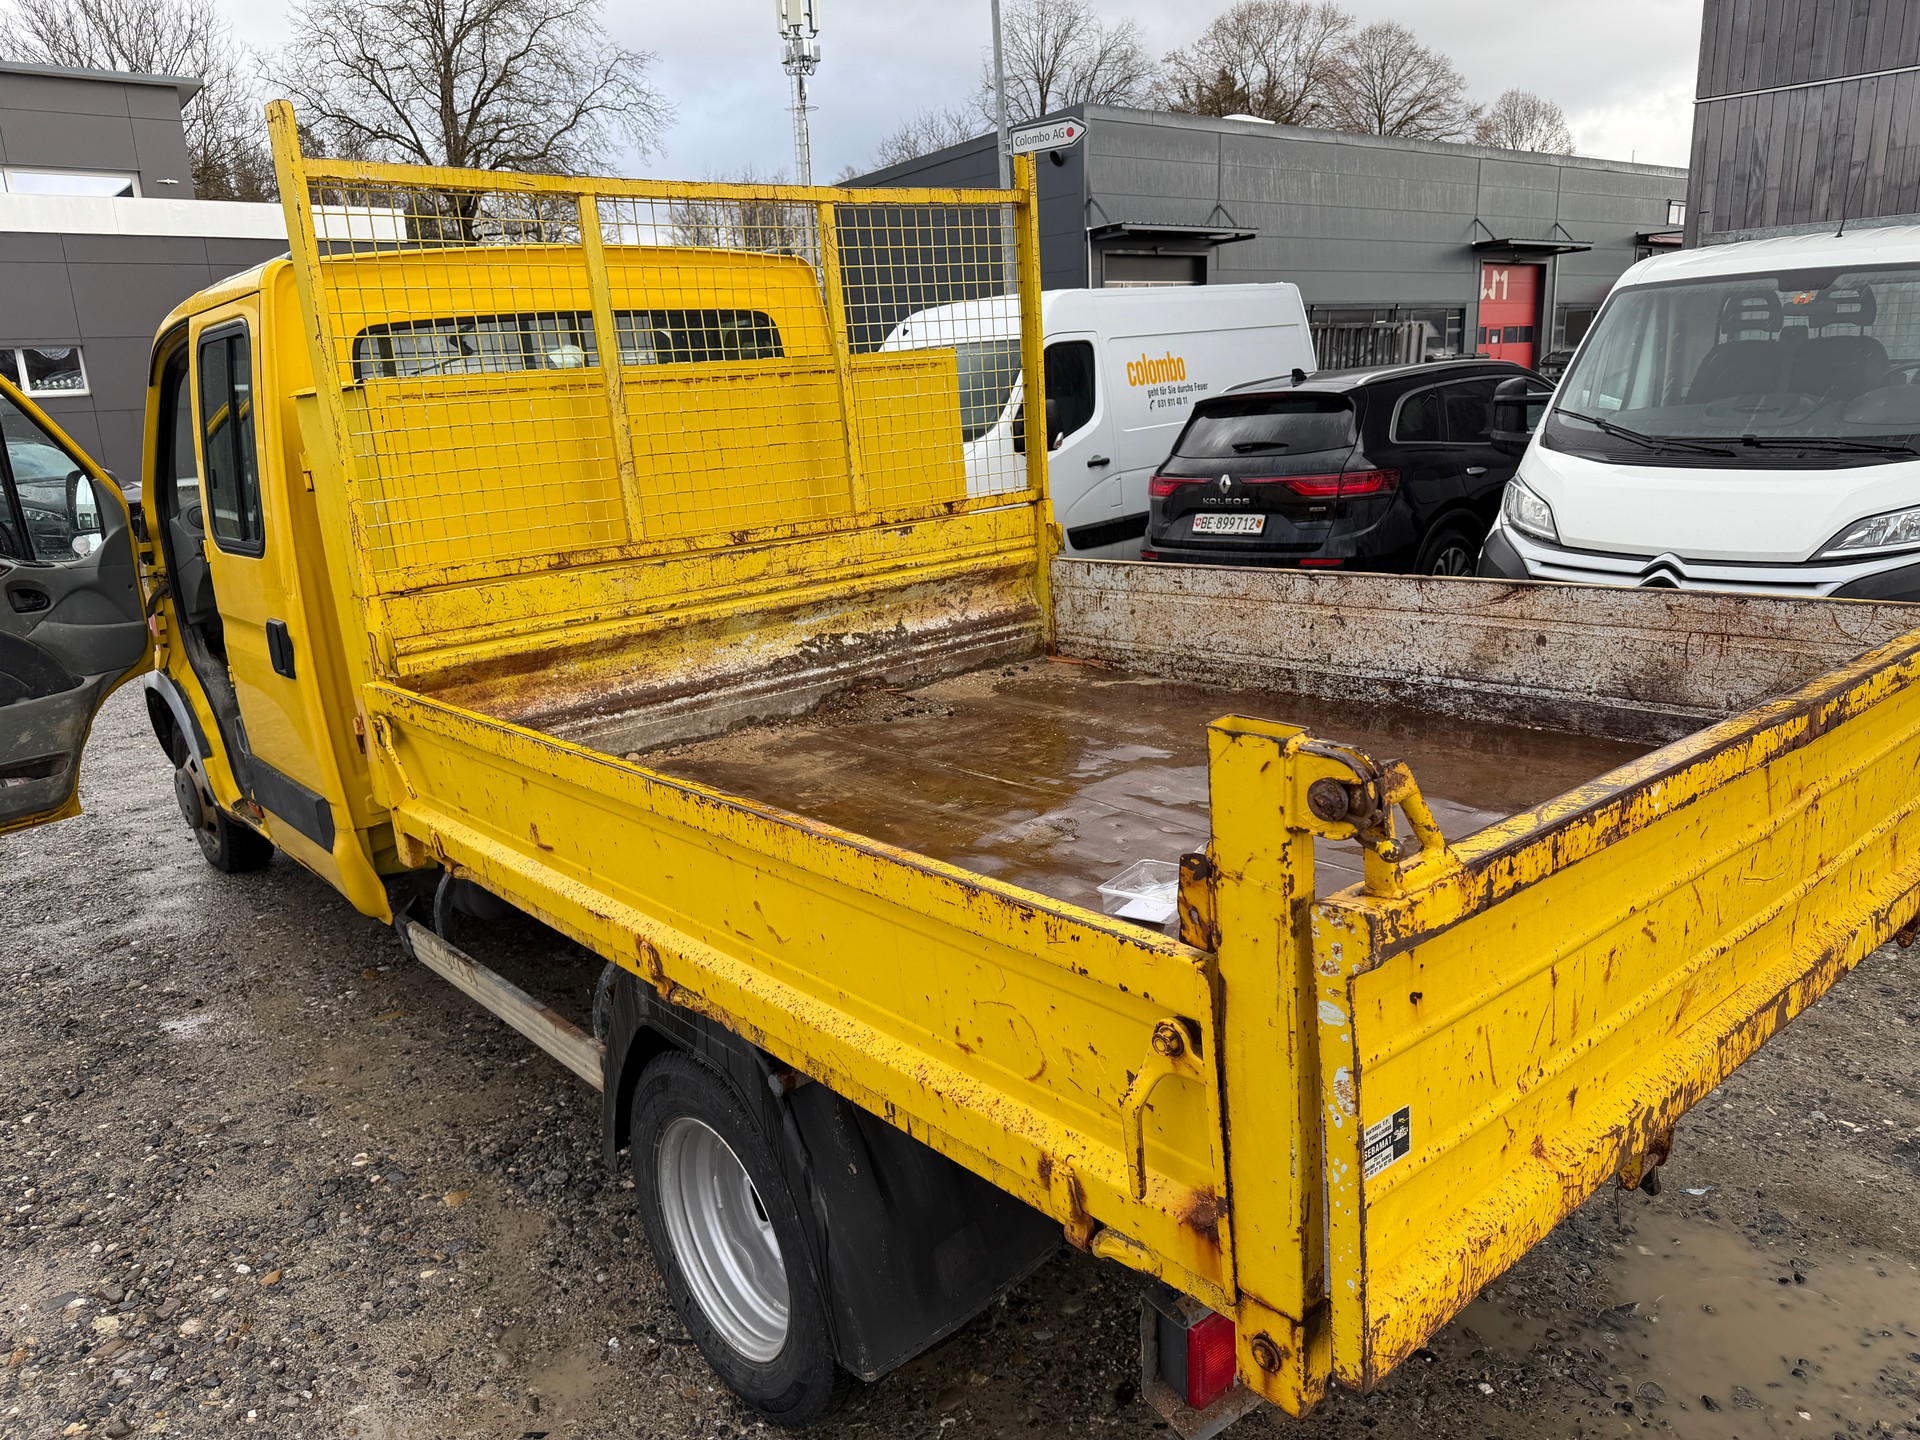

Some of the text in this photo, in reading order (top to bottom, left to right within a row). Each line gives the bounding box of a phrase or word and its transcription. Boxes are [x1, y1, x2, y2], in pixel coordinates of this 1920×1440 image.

[1015, 127, 1065, 147] Colombo AG
[1126, 351, 1186, 387] colombo
[1147, 382, 1208, 399] geht für Sie durchs Feuer
[1157, 399, 1166, 408] 031
[1202, 497, 1250, 505] KOLEOS
[1364, 1135, 1393, 1160] SEBAMAT
